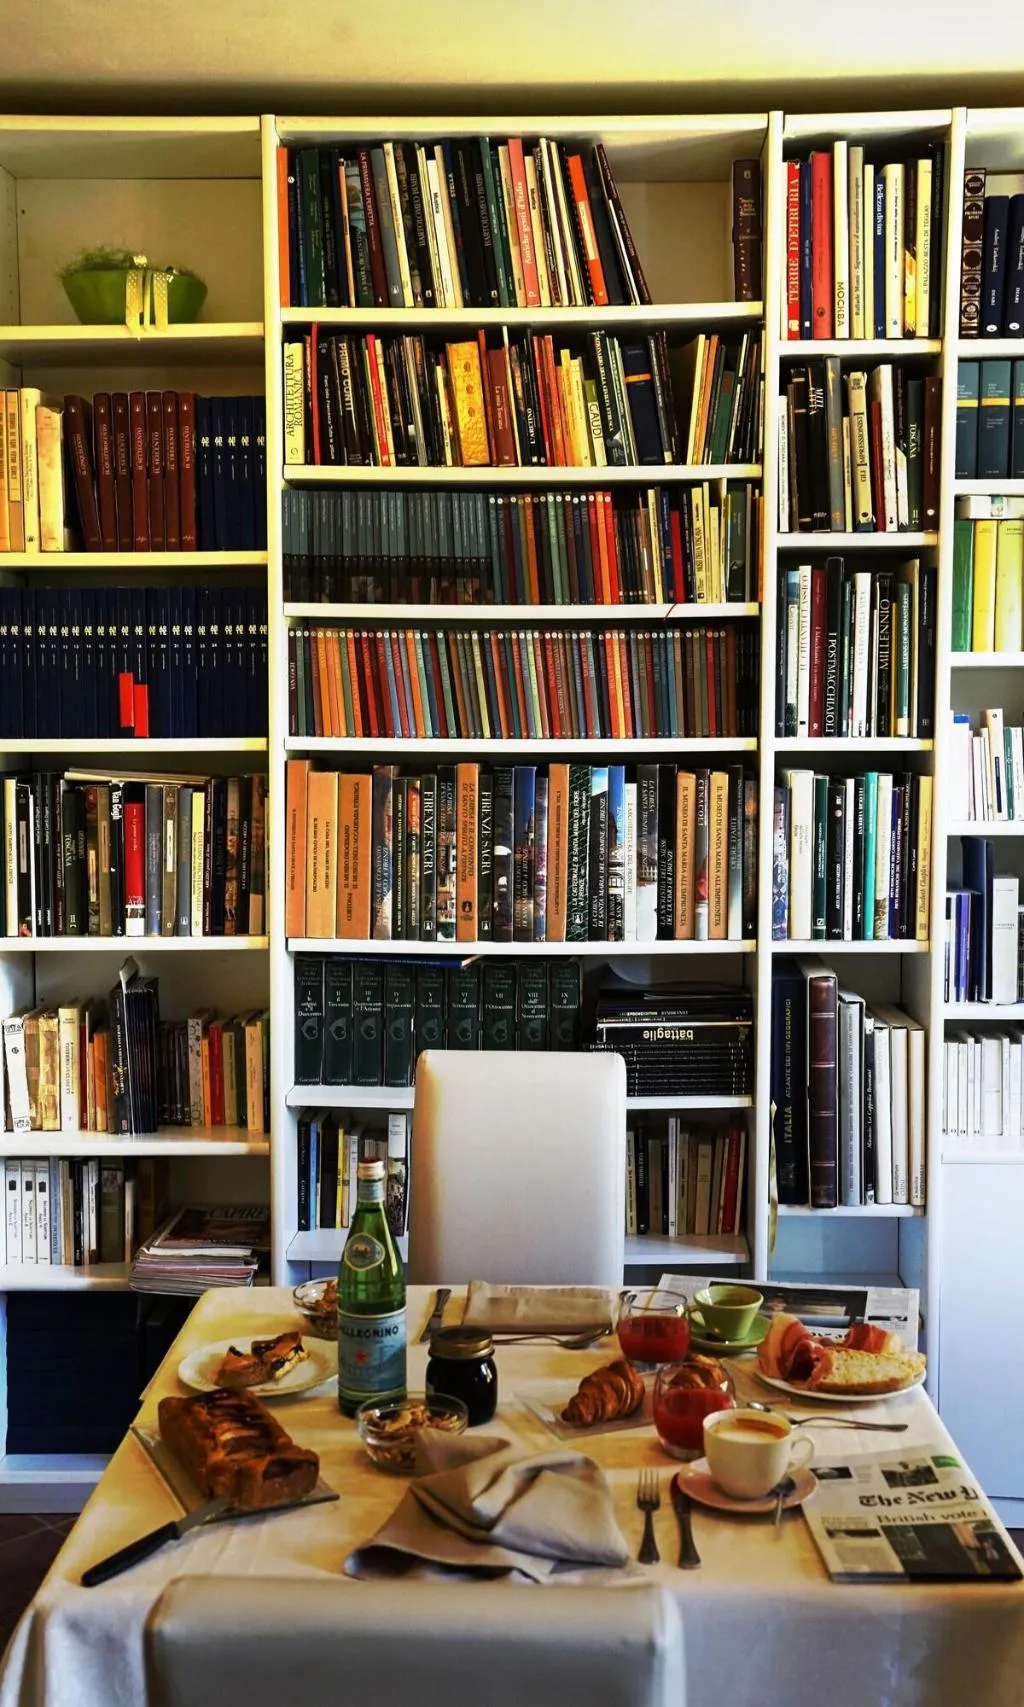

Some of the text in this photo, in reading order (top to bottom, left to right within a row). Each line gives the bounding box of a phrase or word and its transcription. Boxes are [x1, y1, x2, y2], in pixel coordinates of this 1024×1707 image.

[448, 173, 456, 197] STELLA
[876, 184, 884, 235] Bellezza divina
[522, 233, 533, 264] Antiche
[788, 178, 799, 304] TERRE D'ETRURIA
[285, 353, 295, 437] ARCHITETTURA
[339, 343, 353, 411] PRIMO CONTI
[293, 367, 303, 427] ROMANICA
[526, 408, 536, 444] L'ARETINO
[909, 423, 917, 458] TOSCANA
[880, 599, 890, 670] MILLENNIO
[825, 639, 837, 733] POSTMACCHIAIOLI
[469, 783, 475, 792] LA
[649, 780, 655, 789] LA
[111, 791, 122, 820] Van Gogh
[715, 794, 723, 818] MUSEO
[423, 791, 434, 875] FIRENZE SACRA
[481, 791, 492, 875] FIRENZE SACRA
[592, 919, 598, 927] LA
[642, 1027, 694, 1042] battaglie
[784, 999, 792, 1041] GEOGRAFICI
[784, 1106, 793, 1144] ITALIA
[858, 1494, 902, 1508] The
[907, 1488, 955, 1505] New
[876, 1513, 936, 1524] British
[940, 1511, 977, 1520] vote
